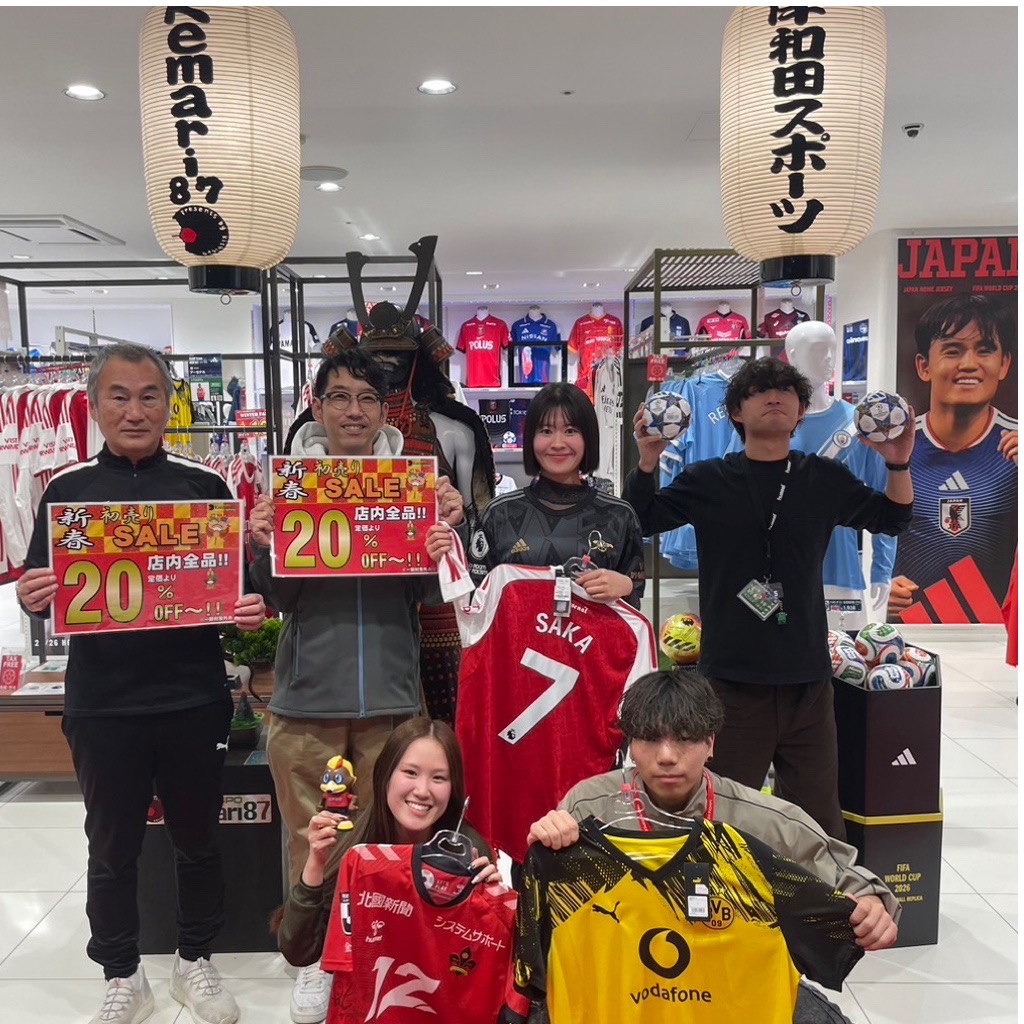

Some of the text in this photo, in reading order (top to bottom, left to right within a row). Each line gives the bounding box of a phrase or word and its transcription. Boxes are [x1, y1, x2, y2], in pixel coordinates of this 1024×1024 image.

[469, 340, 494, 350] POLUS
[481, 414, 507, 424] POLUS
[708, 405, 727, 425] RE
[314, 459, 362, 477] 初売り
[324, 478, 401, 499] SALE
[101, 506, 155, 524] 初売り
[113, 523, 200, 547] SALE
[282, 509, 351, 569] 20
[363, 534, 378, 548] %
[63, 559, 144, 625] 20
[157, 585, 174, 600] %
[34, 639, 59, 647] 2/26
[535, 612, 594, 655] SAKA
[498, 647, 580, 745] 7
[219, 801, 270, 822] ari87
[884, 872, 922, 883] WORLD CUP
[896, 863, 910, 872] FIFA
[357, 890, 414, 917] 北國新聞
[709, 899, 731, 922] VB
[711, 919, 722, 927] 09
[433, 916, 506, 952] システムサポート
[364, 956, 441, 1024] 12
[630, 983, 712, 1005] vodafone
